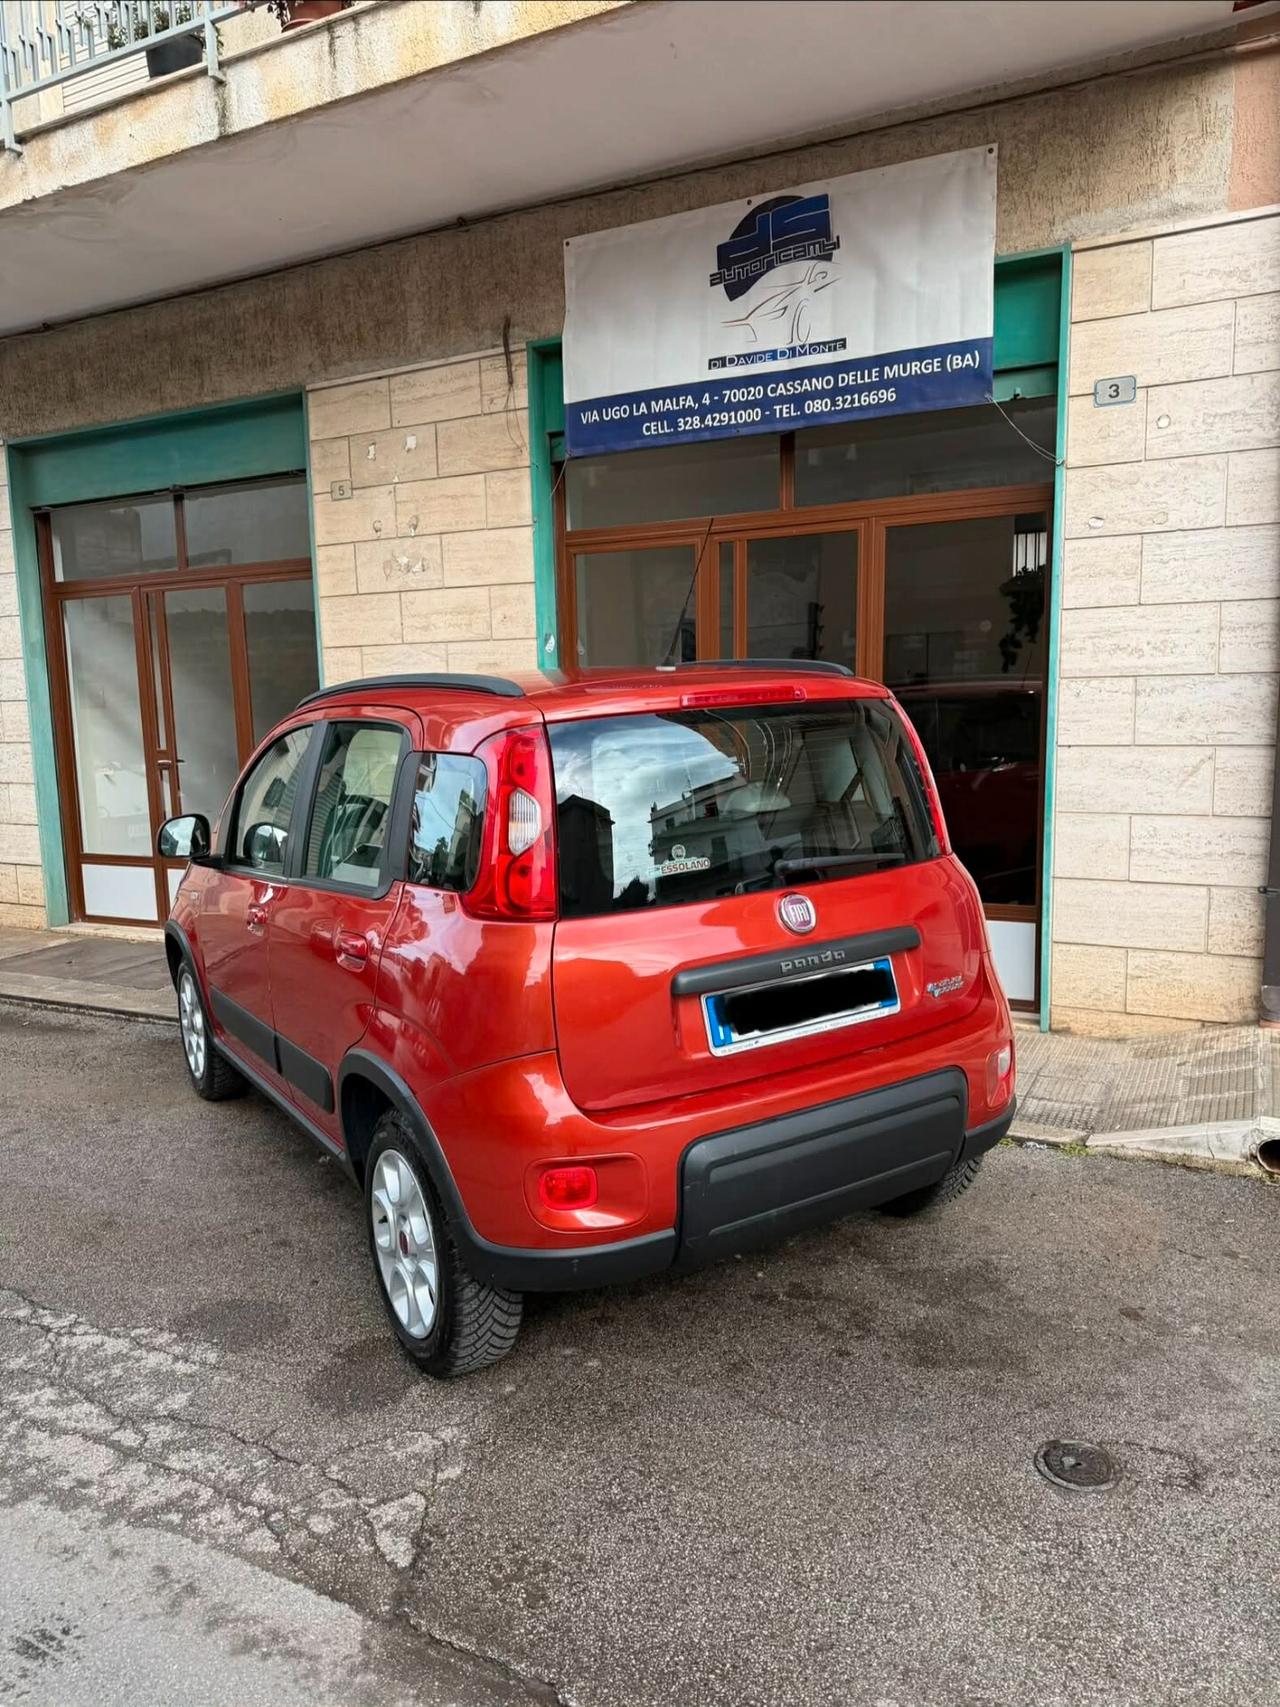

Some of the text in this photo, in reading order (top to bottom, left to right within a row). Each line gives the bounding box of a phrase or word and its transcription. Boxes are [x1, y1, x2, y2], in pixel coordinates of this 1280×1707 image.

[580, 410, 600, 424] VIA
[602, 404, 629, 421] UGO
[633, 403, 648, 416] LA
[651, 395, 699, 413] MALFA,
[702, 392, 710, 406] 4
[723, 385, 764, 404] 70020
[767, 375, 834, 397] CASSANO
[838, 367, 880, 386] DELLE
[884, 357, 942, 380] MURGE
[946, 350, 981, 371] (BA)
[1108, 383, 1120, 399] 3
[642, 421, 674, 436] CELL.
[677, 408, 762, 431] 328.4291000
[773, 403, 801, 418] TEL.
[804, 387, 897, 414] 080.3216696
[788, 902, 811, 922] FIAT
